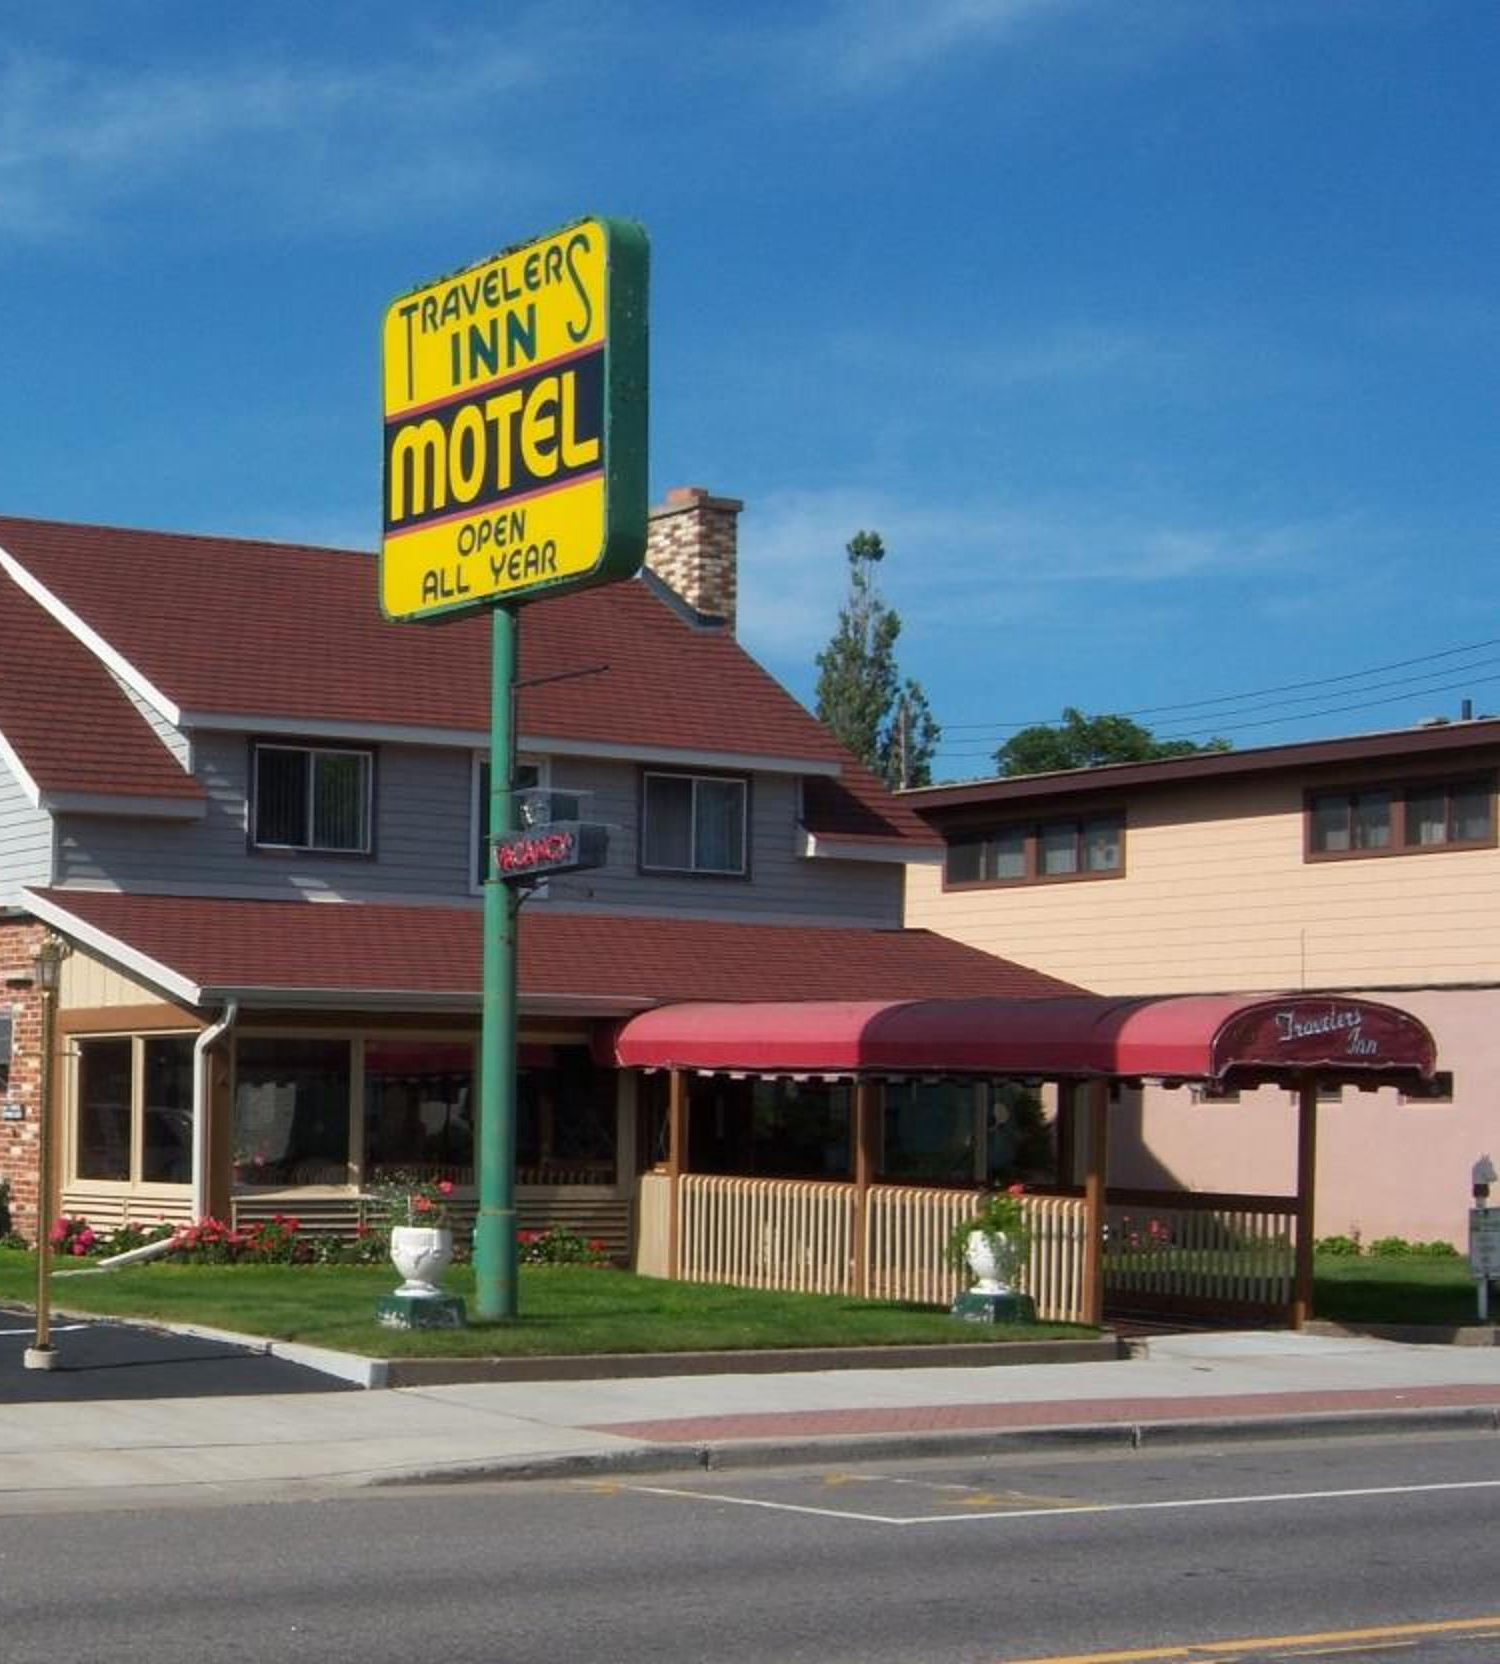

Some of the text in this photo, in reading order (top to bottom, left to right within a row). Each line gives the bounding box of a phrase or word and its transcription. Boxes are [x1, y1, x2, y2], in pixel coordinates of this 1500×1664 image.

[399, 232, 591, 400] TRAVELERS
[450, 302, 539, 386] INN
[390, 370, 599, 522] MOTEL
[457, 509, 527, 557] OPEN
[422, 543, 558, 603] ALL YEAR
[1346, 1026, 1379, 1056] Inn
